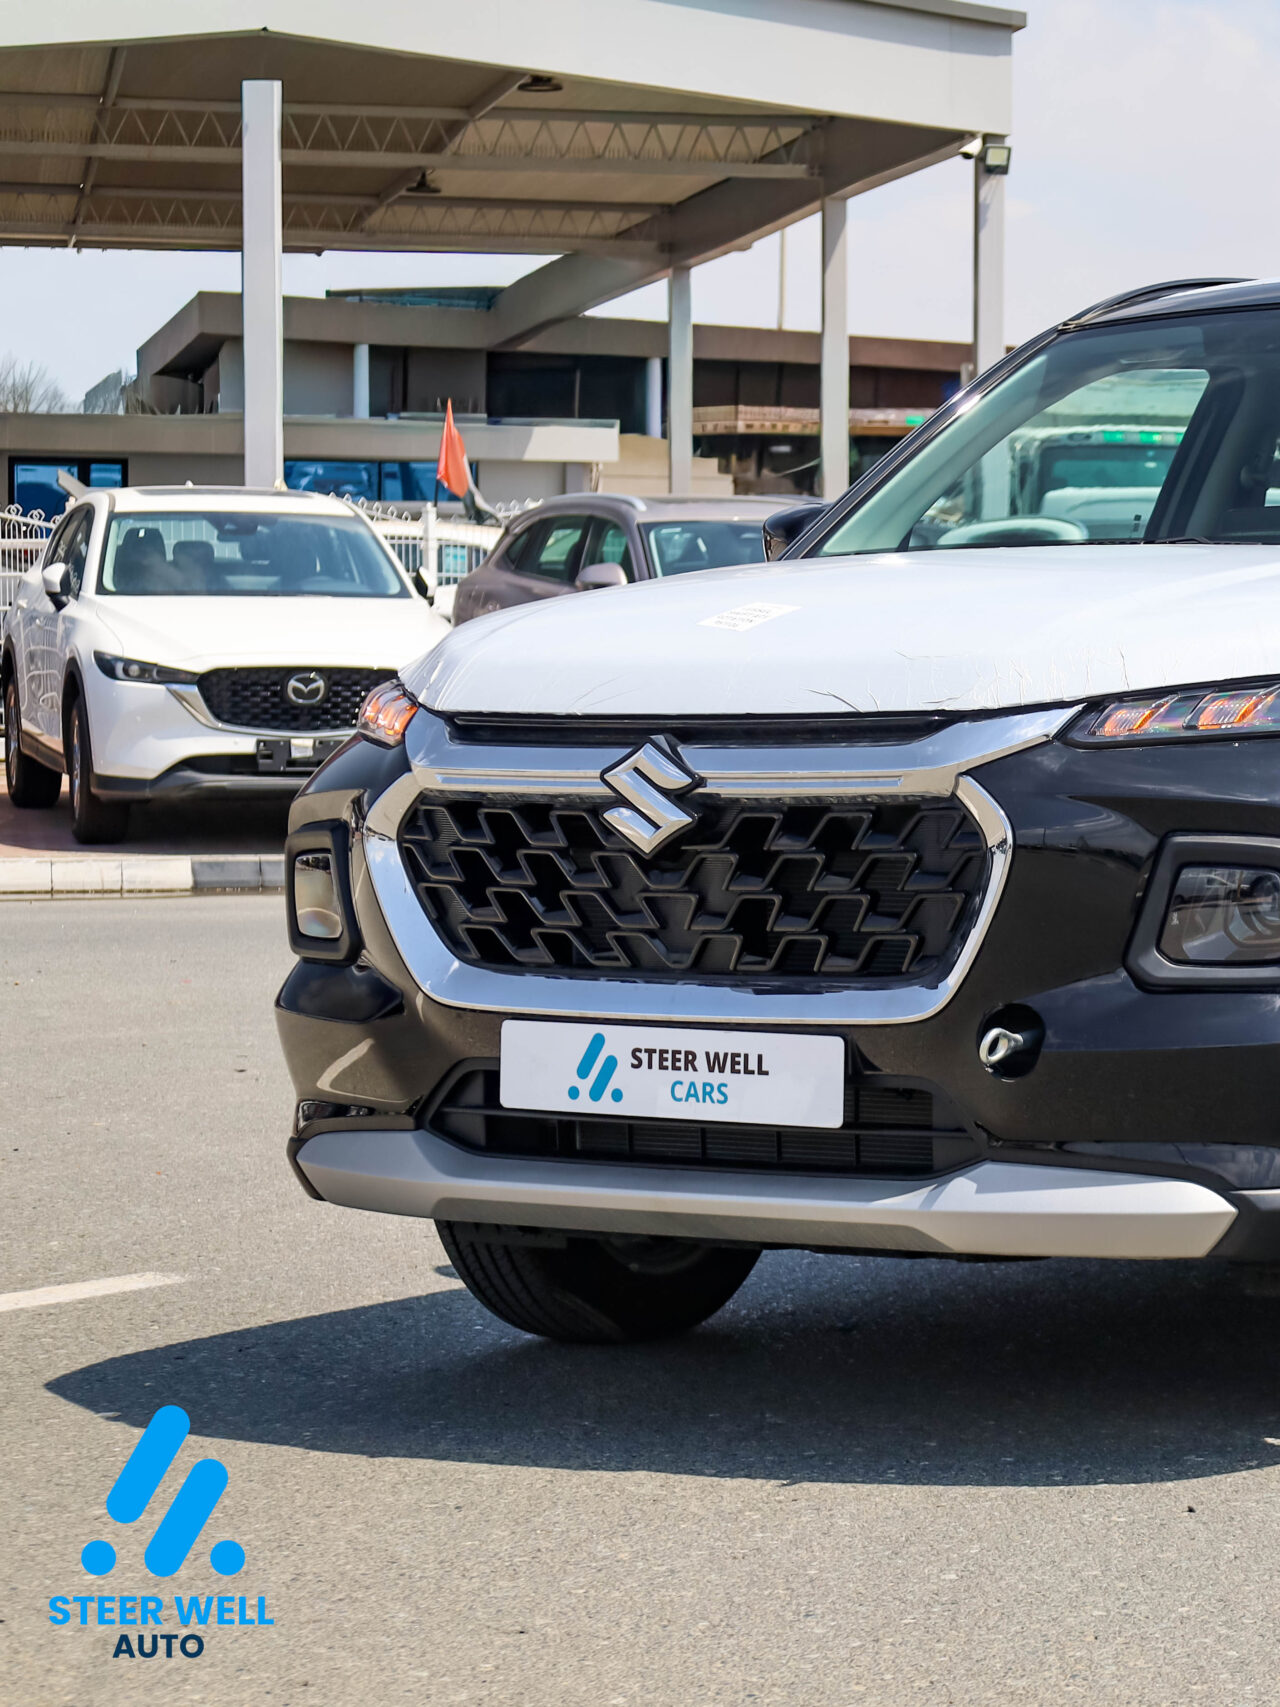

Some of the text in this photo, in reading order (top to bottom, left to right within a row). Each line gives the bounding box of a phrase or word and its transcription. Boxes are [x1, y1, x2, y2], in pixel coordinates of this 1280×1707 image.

[631, 1047, 769, 1075] STEER WELL
[671, 1080, 728, 1104] CARS
